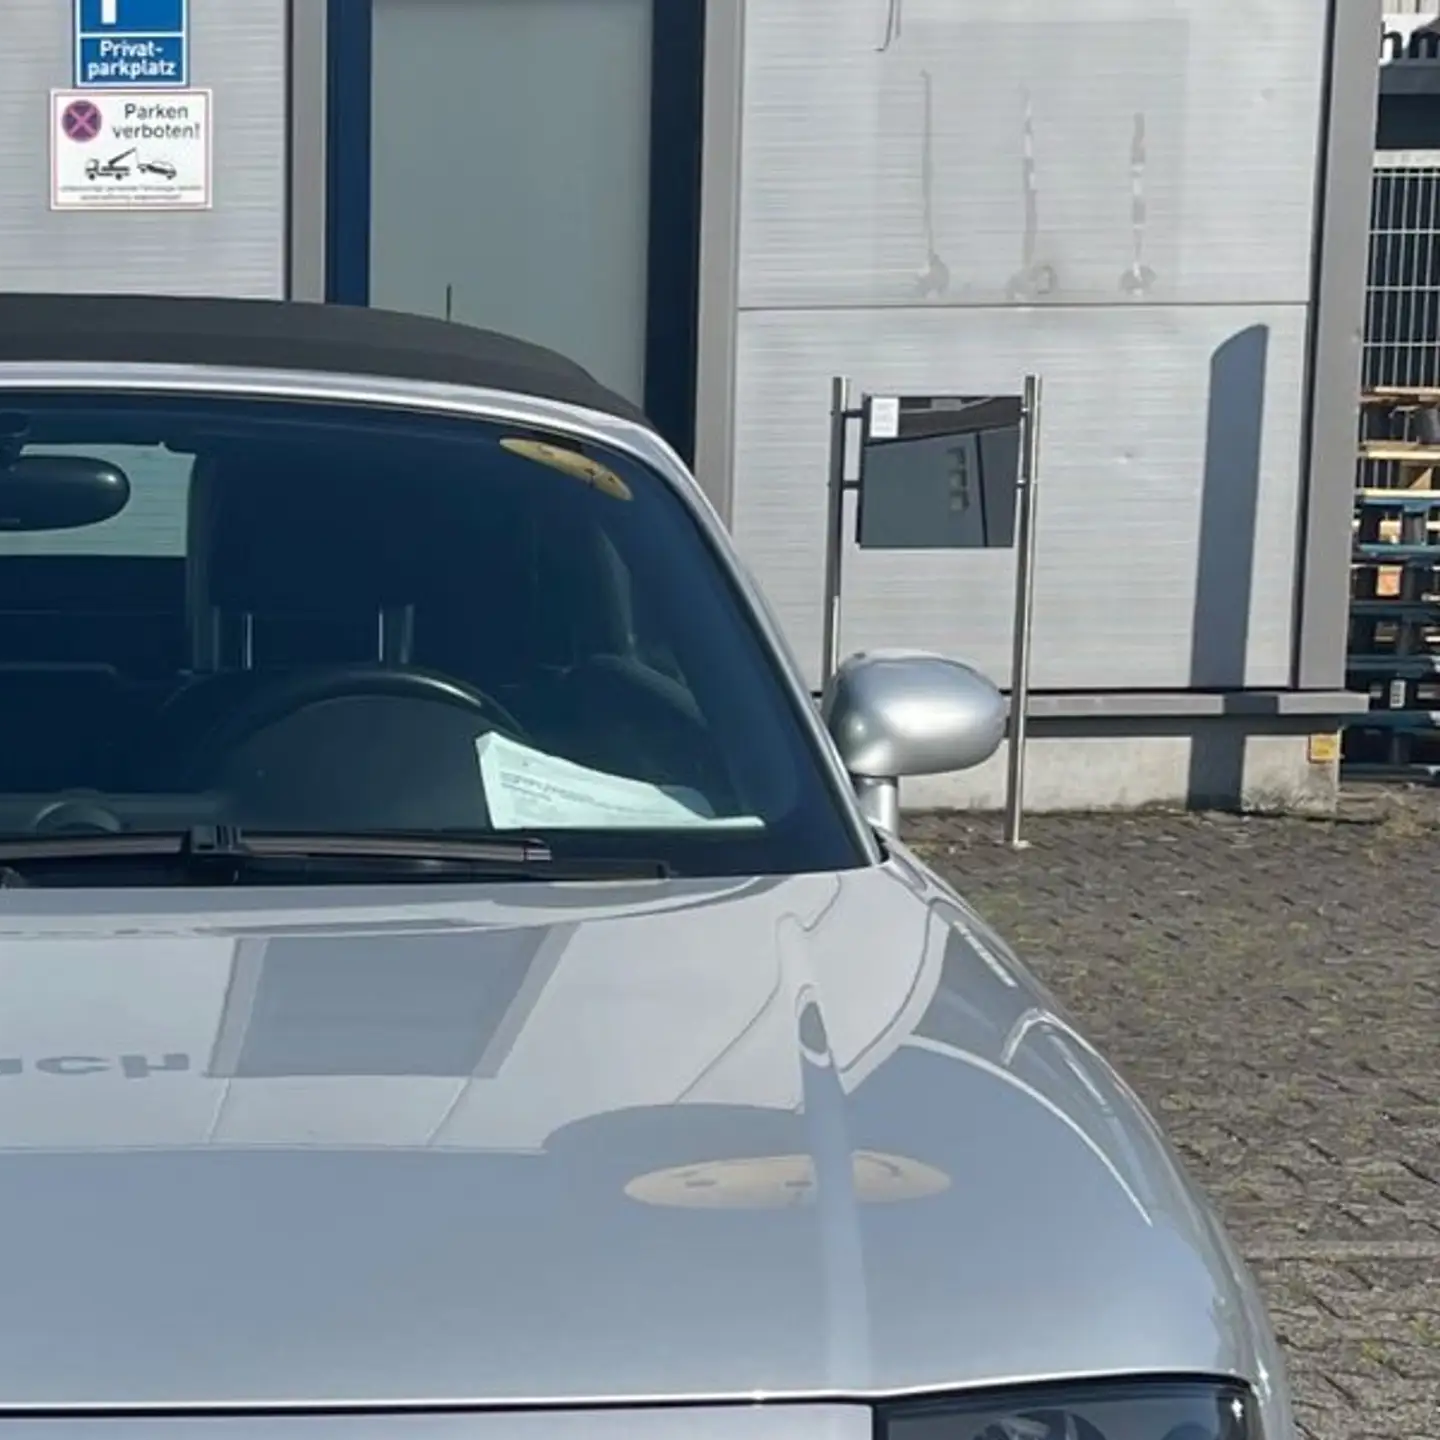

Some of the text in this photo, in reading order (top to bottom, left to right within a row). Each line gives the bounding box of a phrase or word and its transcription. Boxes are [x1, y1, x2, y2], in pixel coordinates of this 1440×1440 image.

[99, 40, 164, 57] Privat-
[87, 61, 177, 80] parkplatz
[124, 103, 189, 121] Parken
[112, 122, 201, 139] verboten!
